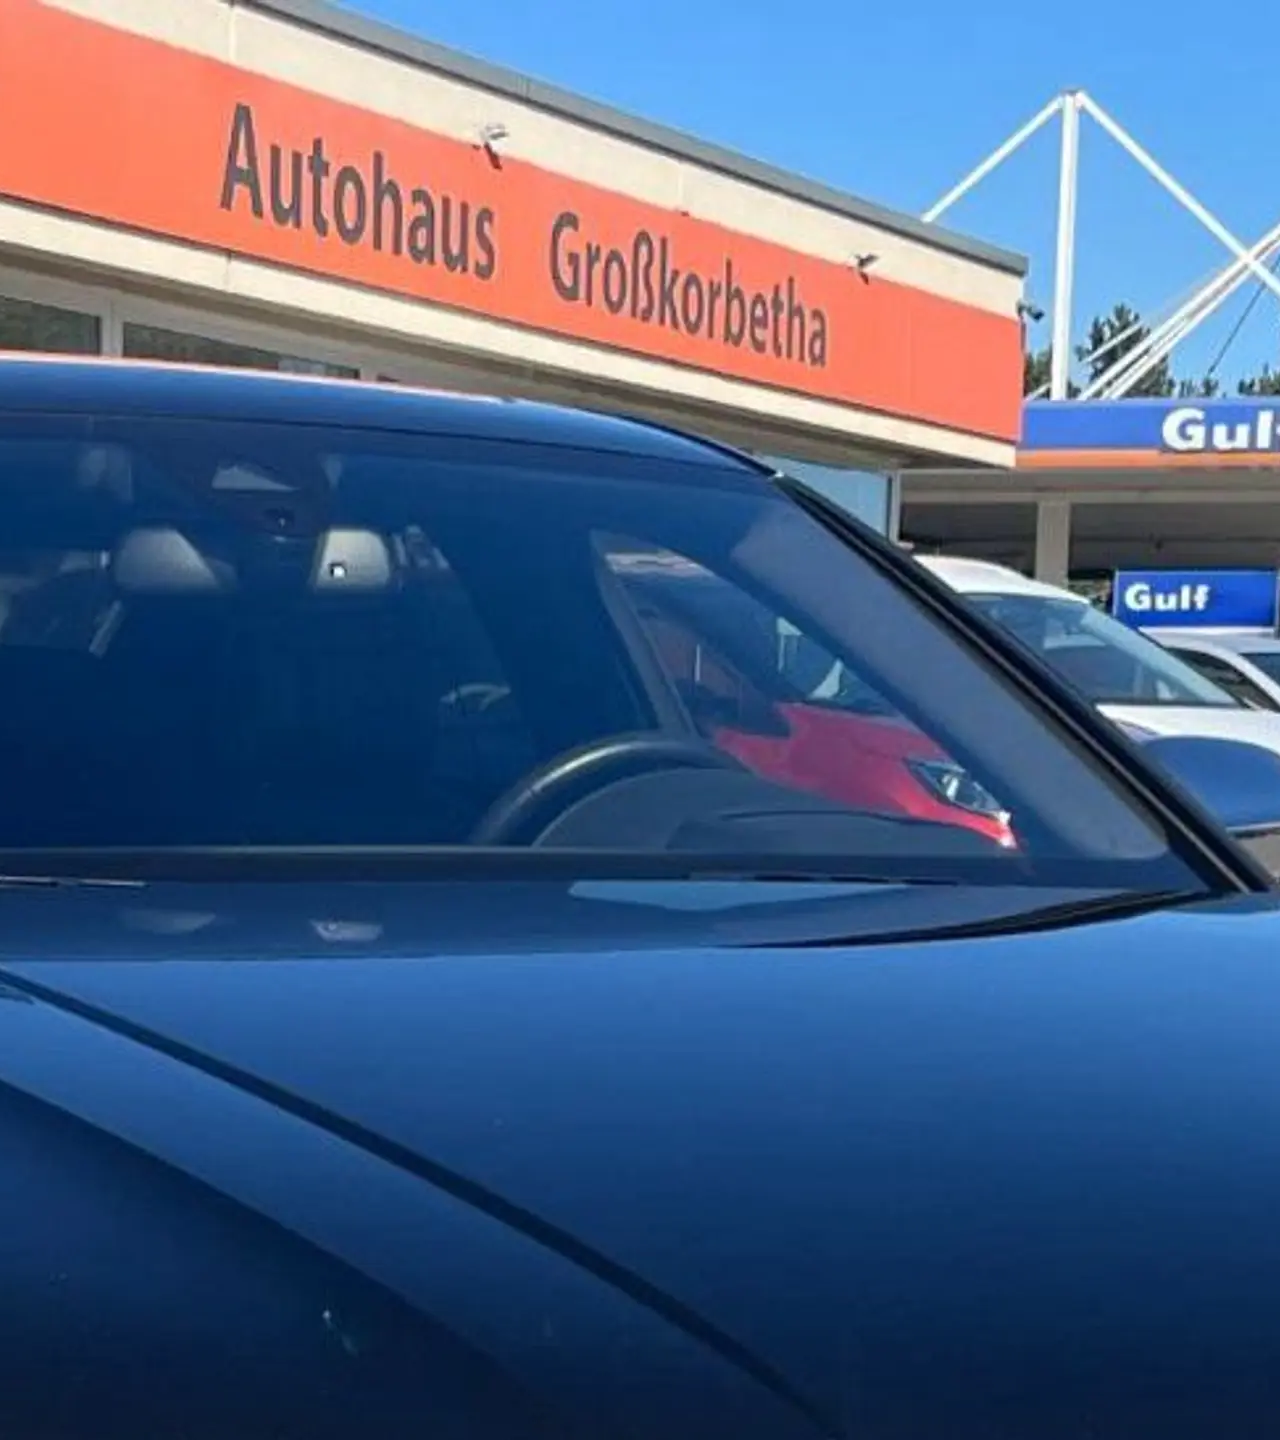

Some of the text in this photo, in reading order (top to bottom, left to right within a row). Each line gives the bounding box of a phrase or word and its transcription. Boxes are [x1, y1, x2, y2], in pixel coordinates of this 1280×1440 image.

[220, 102, 828, 368] Autohaus Großkorbetha
[1124, 583, 1209, 612] Gulf
